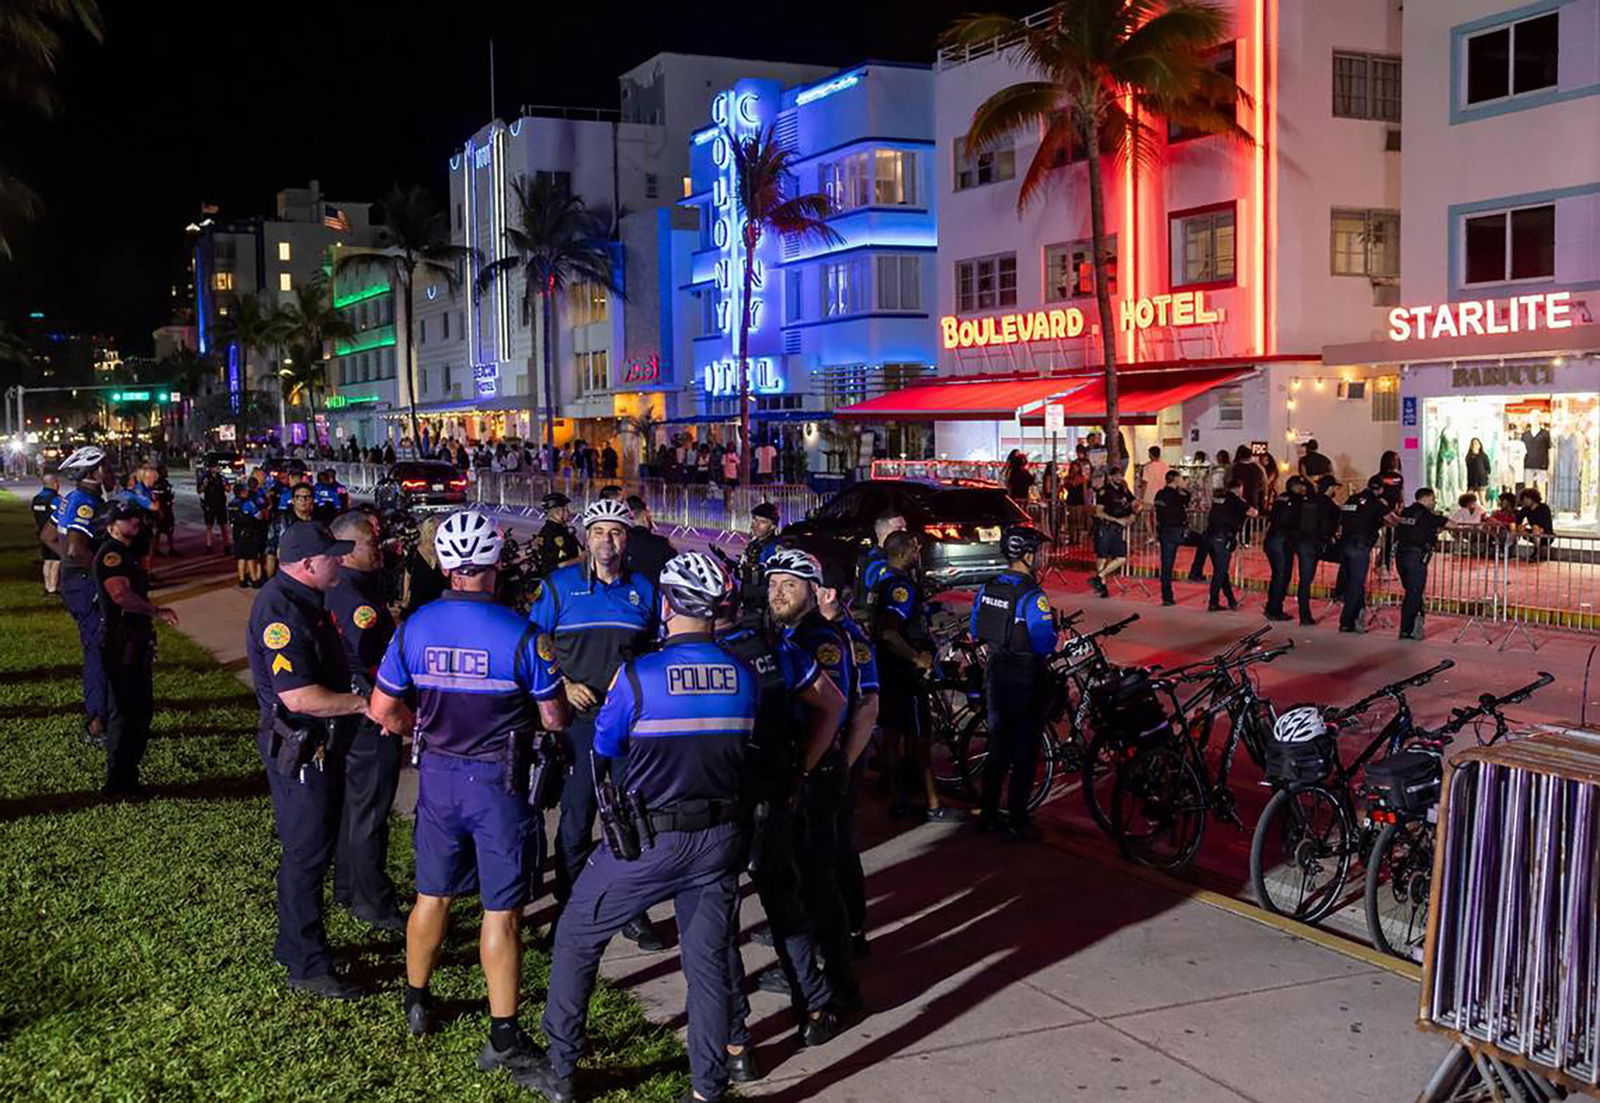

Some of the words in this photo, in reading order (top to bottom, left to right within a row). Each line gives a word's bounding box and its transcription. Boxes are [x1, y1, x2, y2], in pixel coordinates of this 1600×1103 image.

[711, 92, 731, 333] COLONY
[738, 92, 764, 333] COONY
[940, 308, 1084, 349] BOULEVARD
[1119, 291, 1218, 333] HOTEL
[1389, 291, 1572, 341] STARLITE
[981, 594, 1010, 609] POLICE
[426, 649, 487, 676] POLICE
[668, 665, 736, 692] POLICE
